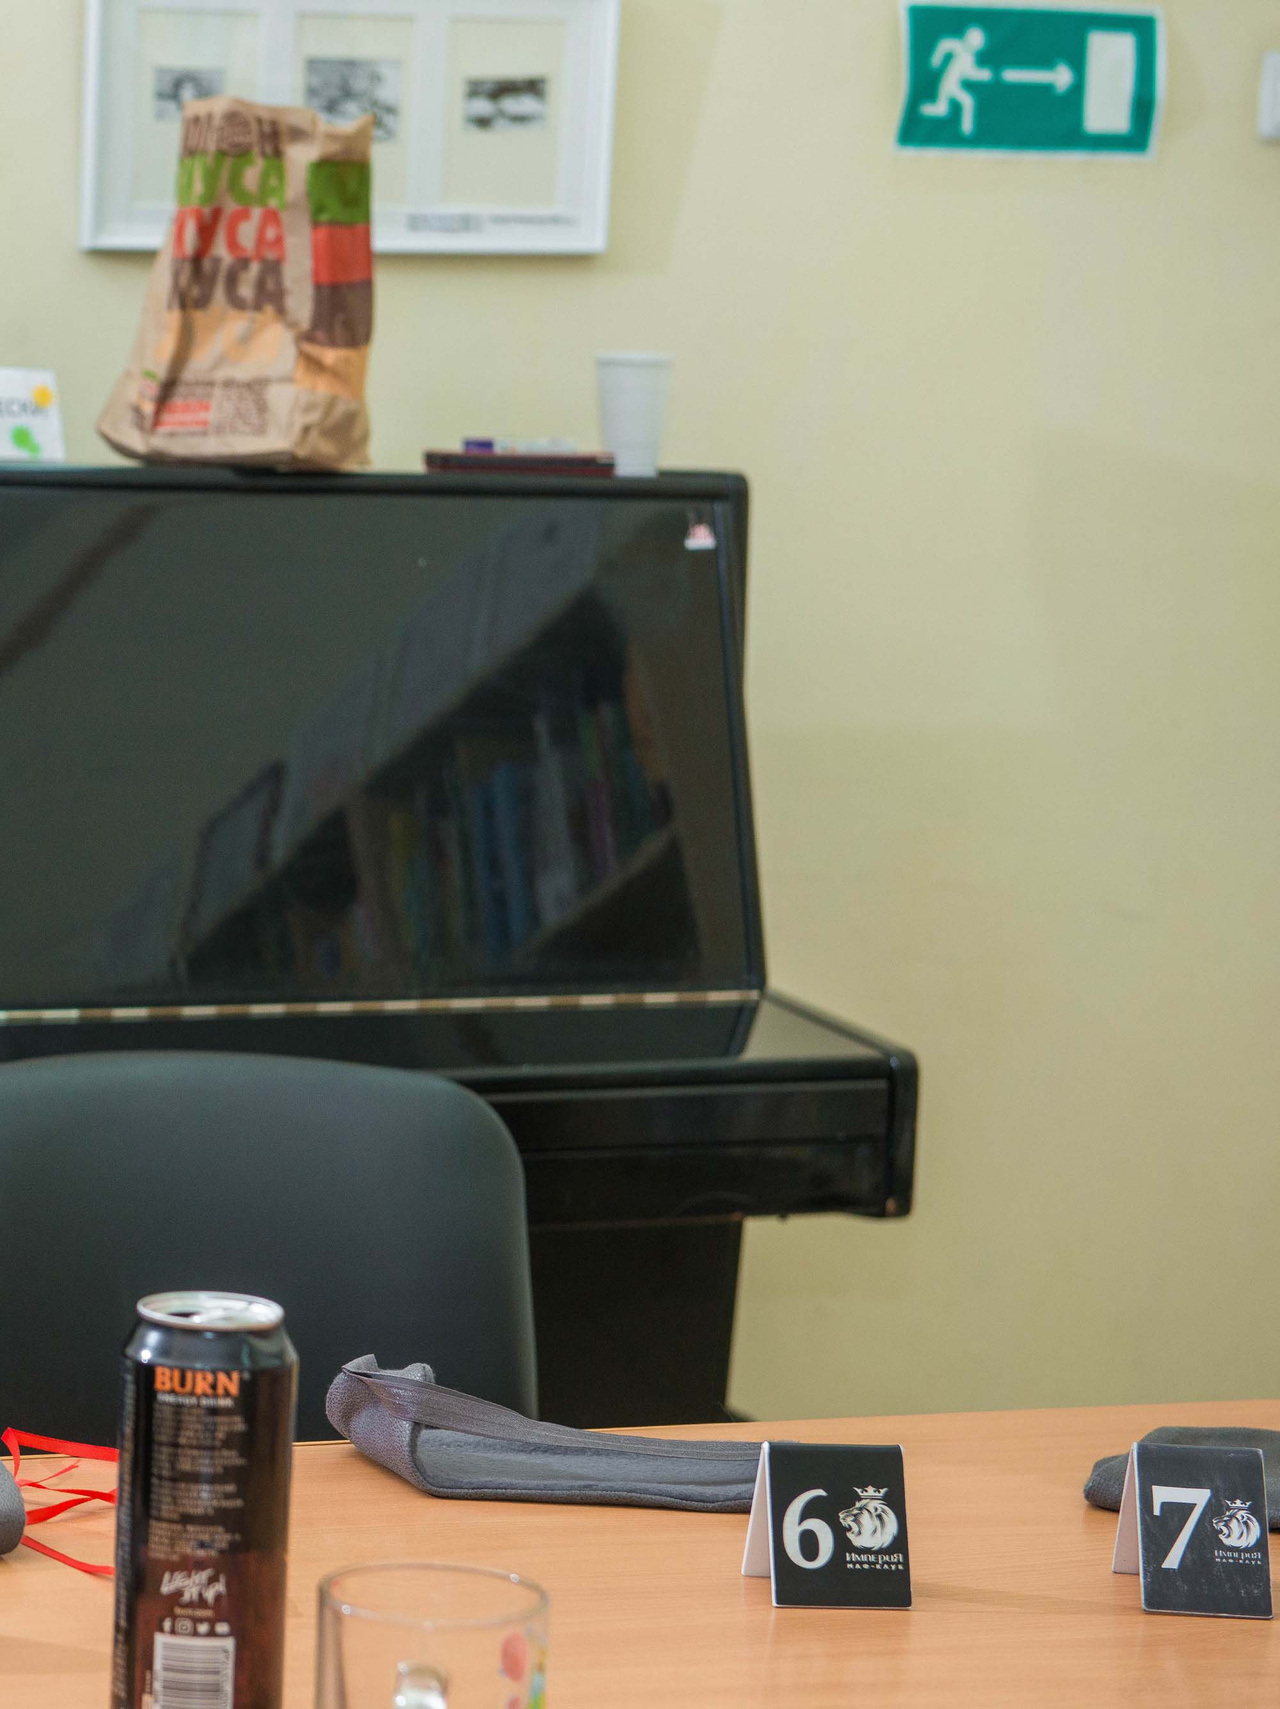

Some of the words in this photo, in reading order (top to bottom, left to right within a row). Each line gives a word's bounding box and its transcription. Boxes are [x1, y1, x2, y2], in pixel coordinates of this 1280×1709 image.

[154, 1365, 239, 1397] BURN
[782, 1488, 835, 1570] 6
[1151, 1485, 1213, 1570] 7
